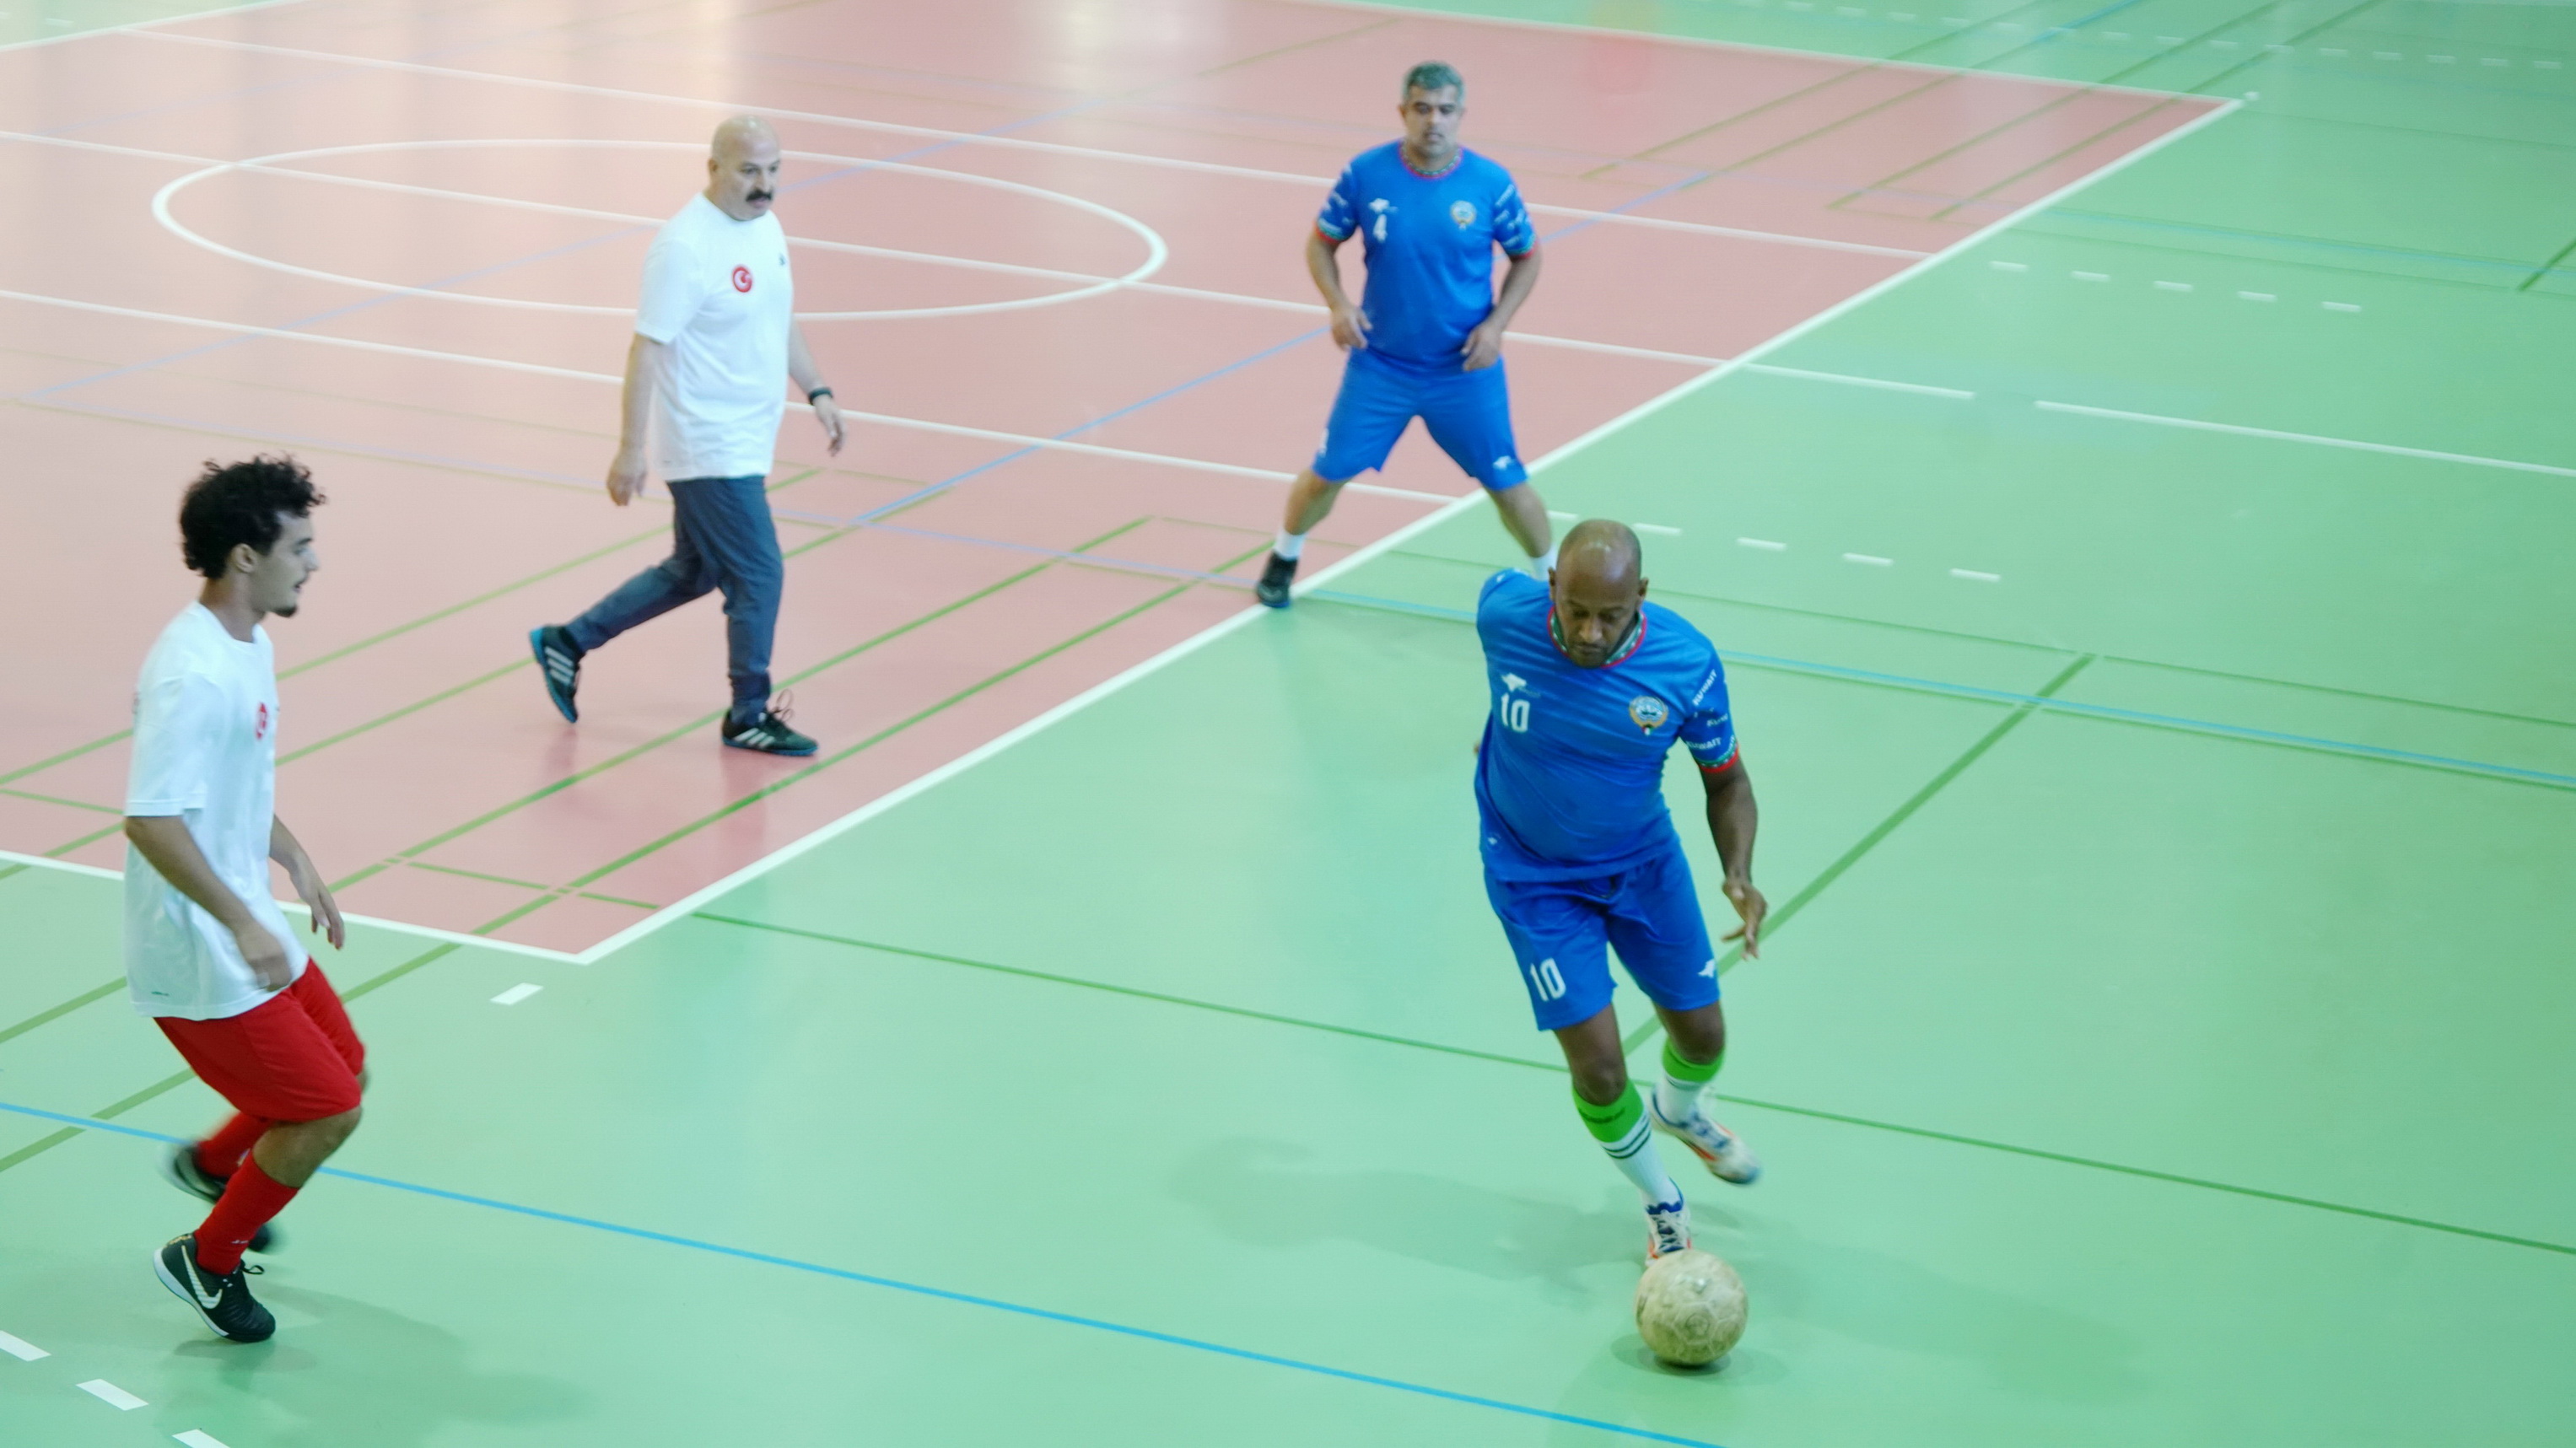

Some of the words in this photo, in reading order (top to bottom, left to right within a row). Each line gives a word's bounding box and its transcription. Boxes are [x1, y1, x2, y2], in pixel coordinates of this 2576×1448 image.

[1692, 668, 1717, 707] KUWAIT
[1501, 692, 1531, 733] 10
[1529, 957, 1566, 1002] 10
